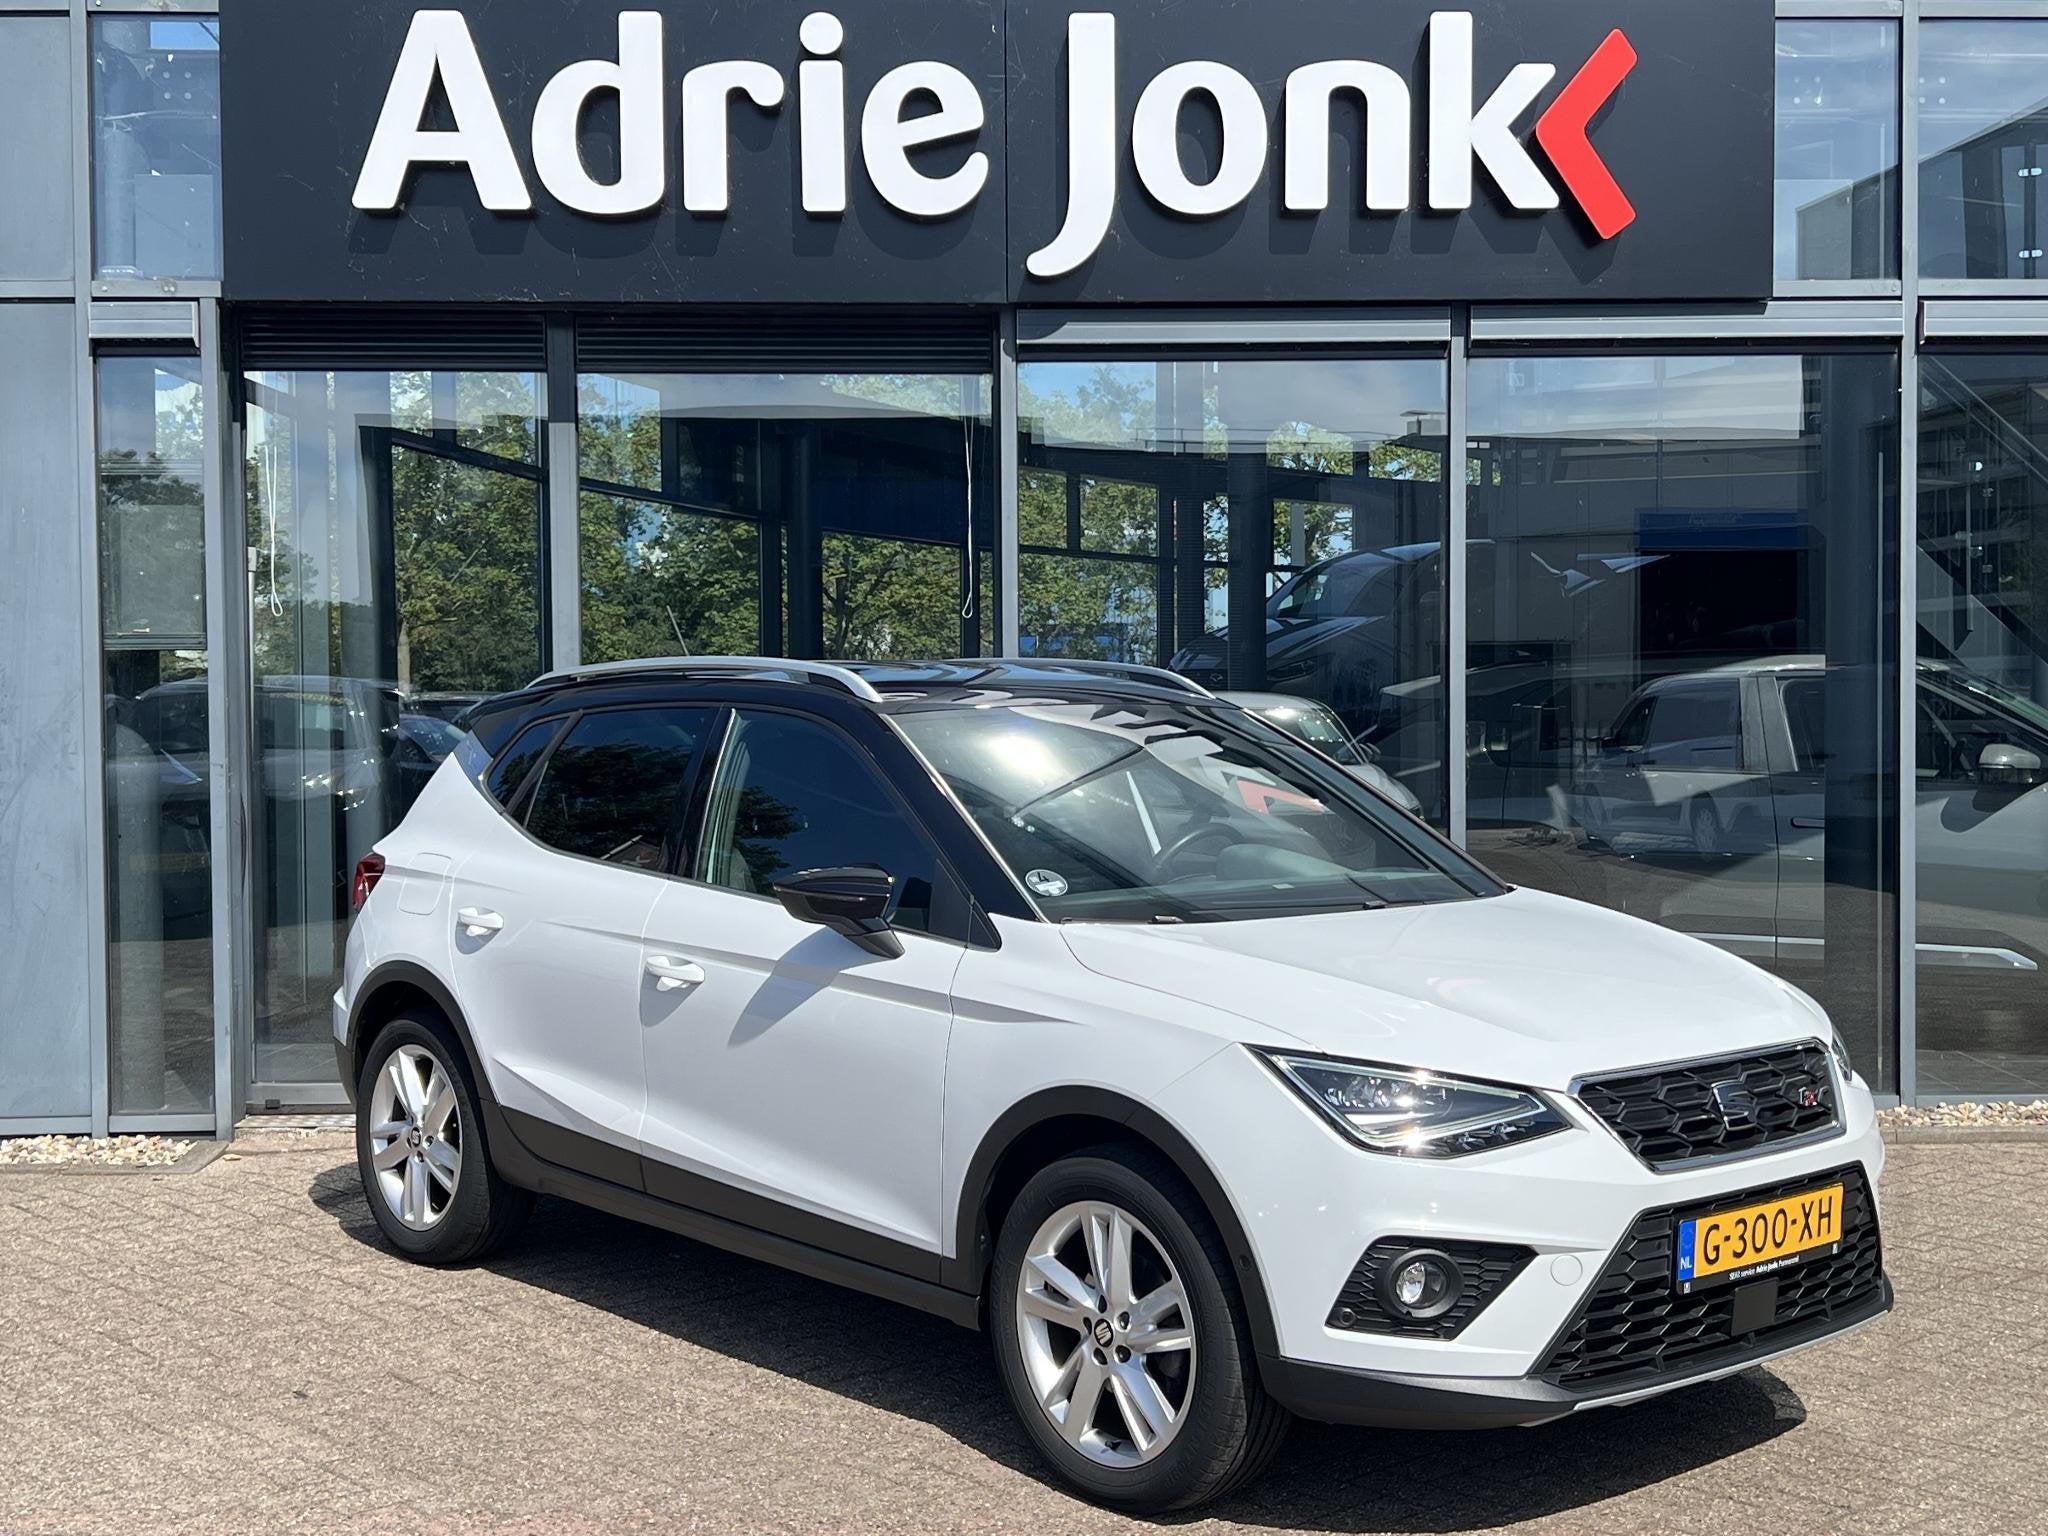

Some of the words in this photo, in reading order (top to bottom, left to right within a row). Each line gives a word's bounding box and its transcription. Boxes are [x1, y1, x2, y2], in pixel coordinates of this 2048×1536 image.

[352, 9, 990, 215] Adrie
[1026, 10, 1561, 277] Jonk
[1680, 1255, 1693, 1271] NL
[1704, 1196, 1833, 1265] G-300-XH
